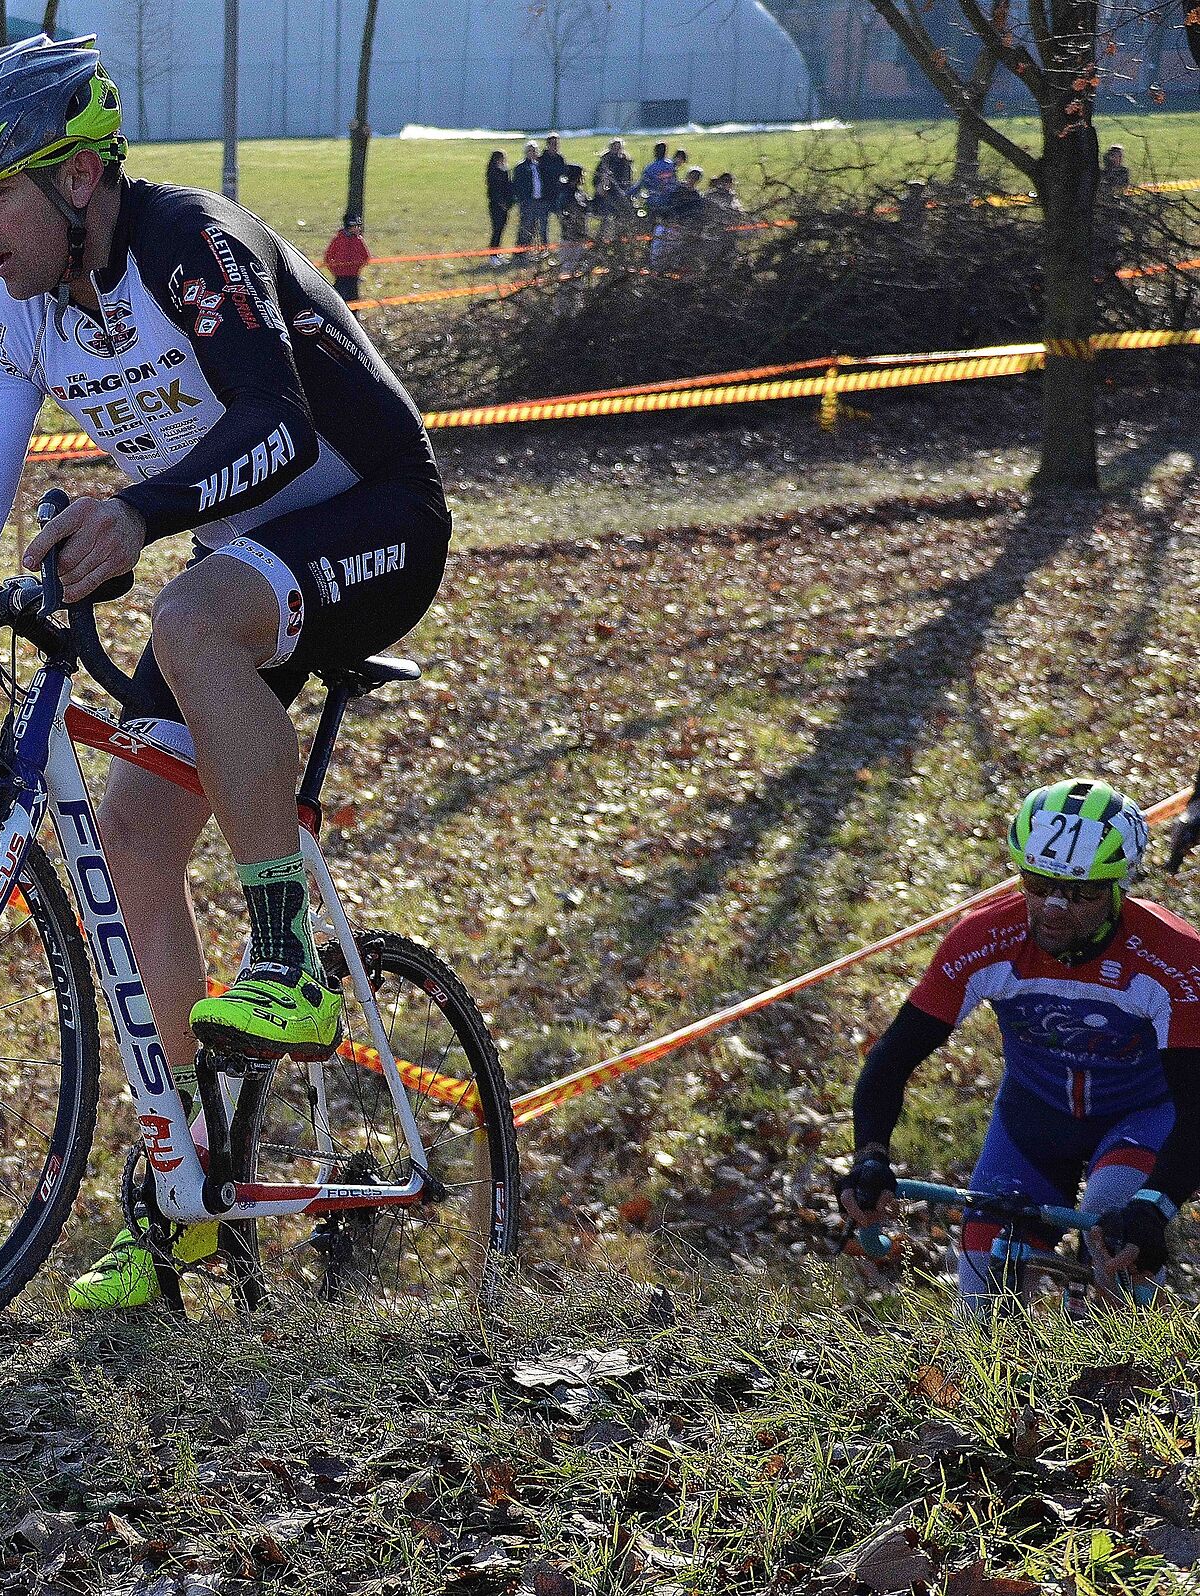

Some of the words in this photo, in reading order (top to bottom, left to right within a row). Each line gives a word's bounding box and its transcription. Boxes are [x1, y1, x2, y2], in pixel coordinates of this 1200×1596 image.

[205, 225, 241, 282] ELETTRO
[325, 323, 359, 356] GUALTIERI
[67, 361, 158, 400] ARGON
[156, 348, 187, 370] 18
[81, 377, 203, 431] TECK
[189, 422, 296, 512] HICARI
[337, 543, 406, 587] HICARI
[108, 731, 147, 755] CX
[1040, 814, 1083, 864] 21
[58, 800, 173, 1096] FOCUS
[327, 1188, 382, 1198] FOCUS
